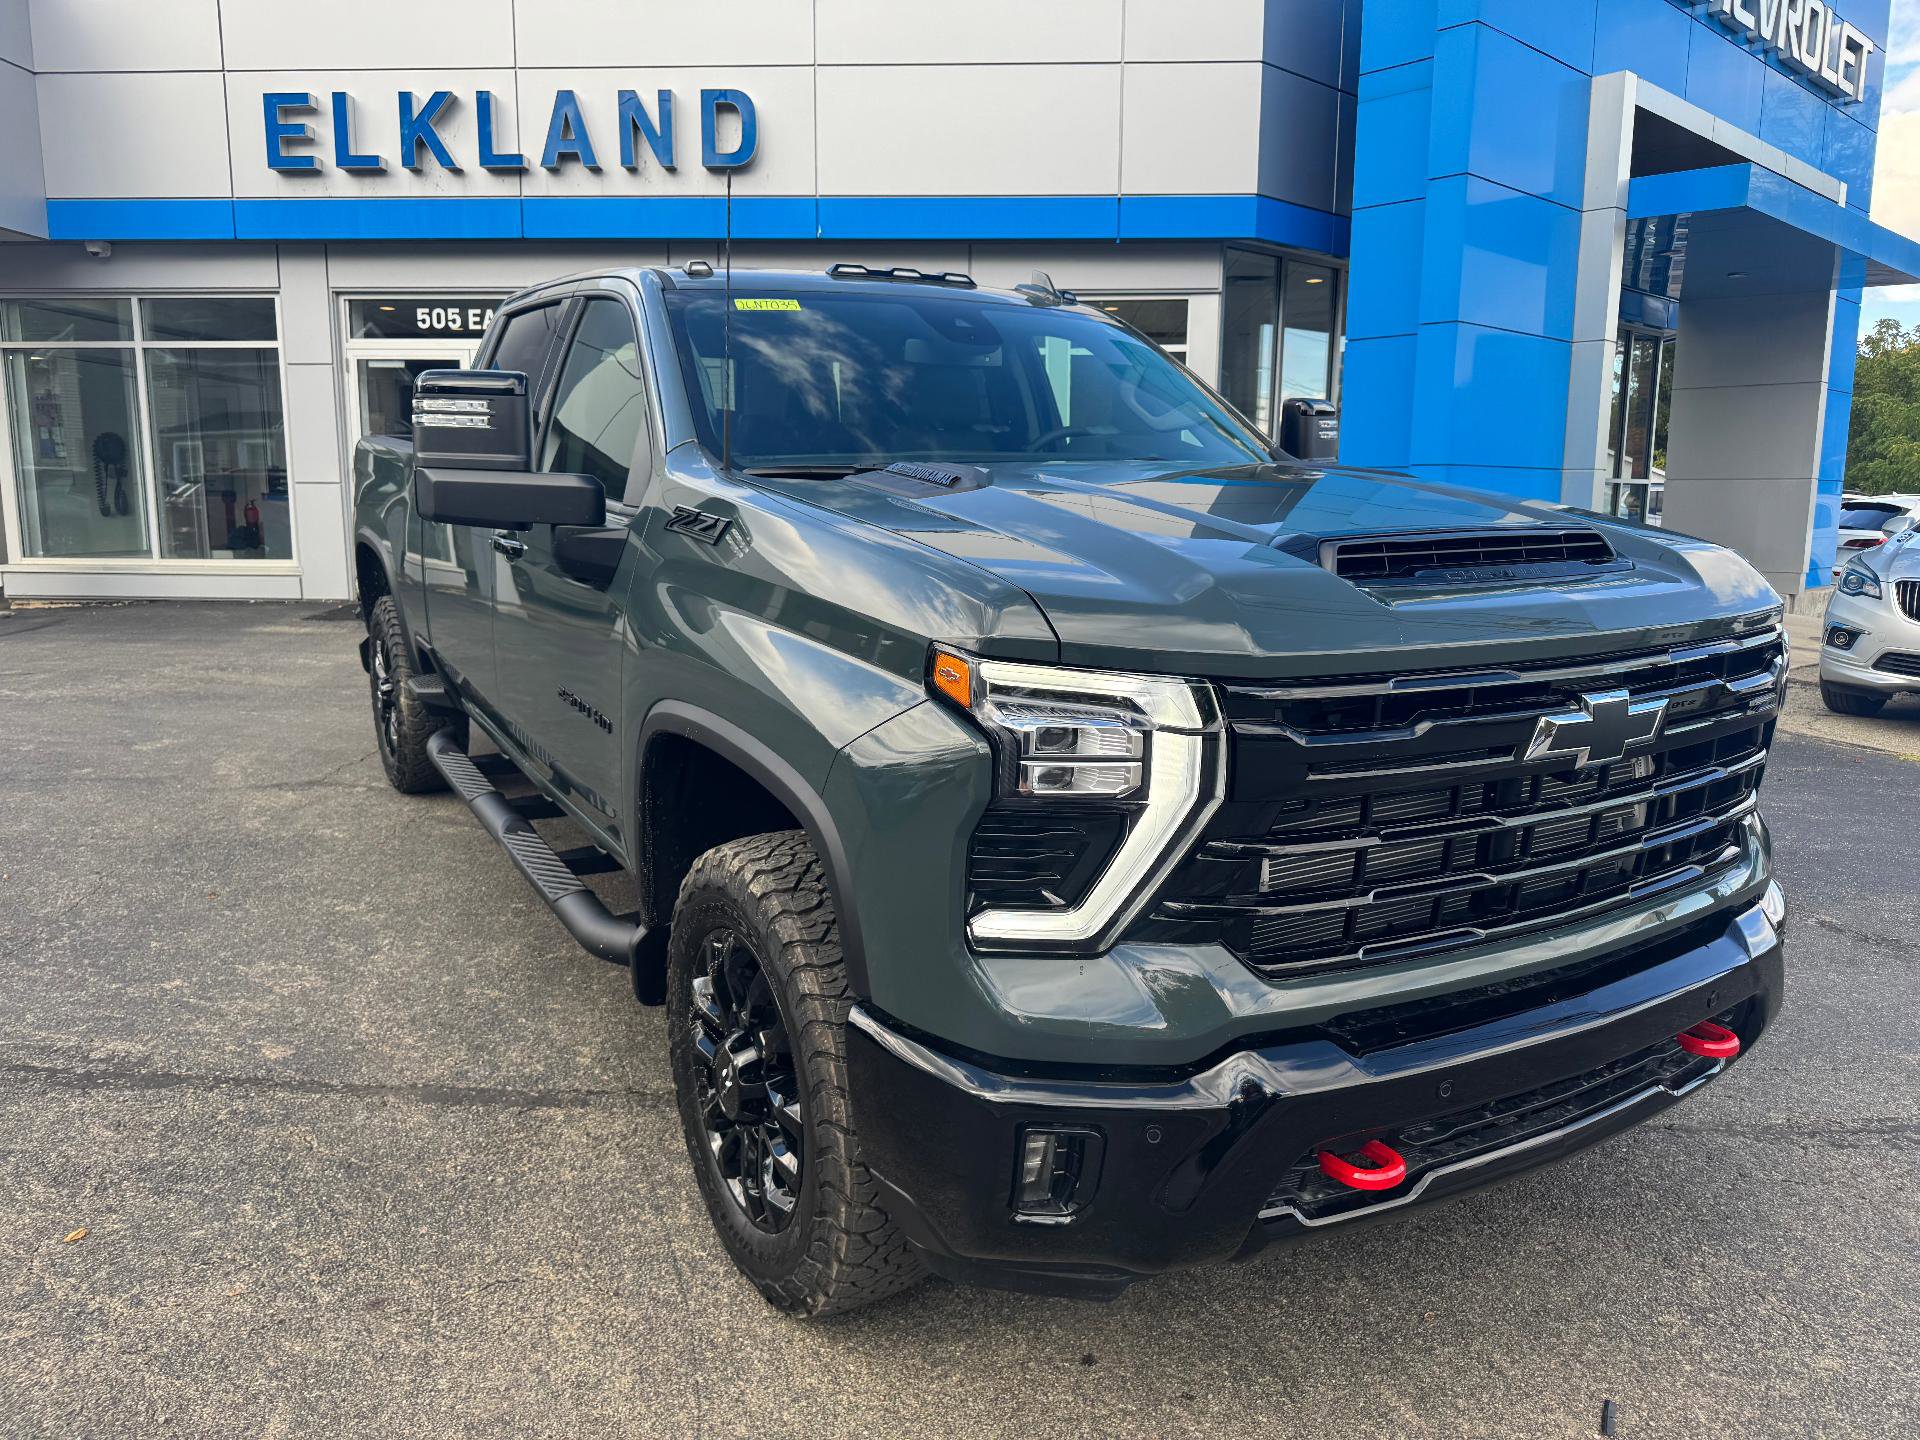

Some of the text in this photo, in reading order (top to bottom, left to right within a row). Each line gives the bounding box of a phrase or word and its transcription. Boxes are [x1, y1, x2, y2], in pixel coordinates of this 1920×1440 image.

[263, 88, 761, 172] ELKLAND
[416, 307, 462, 330] 505
[664, 504, 733, 545] Z71
